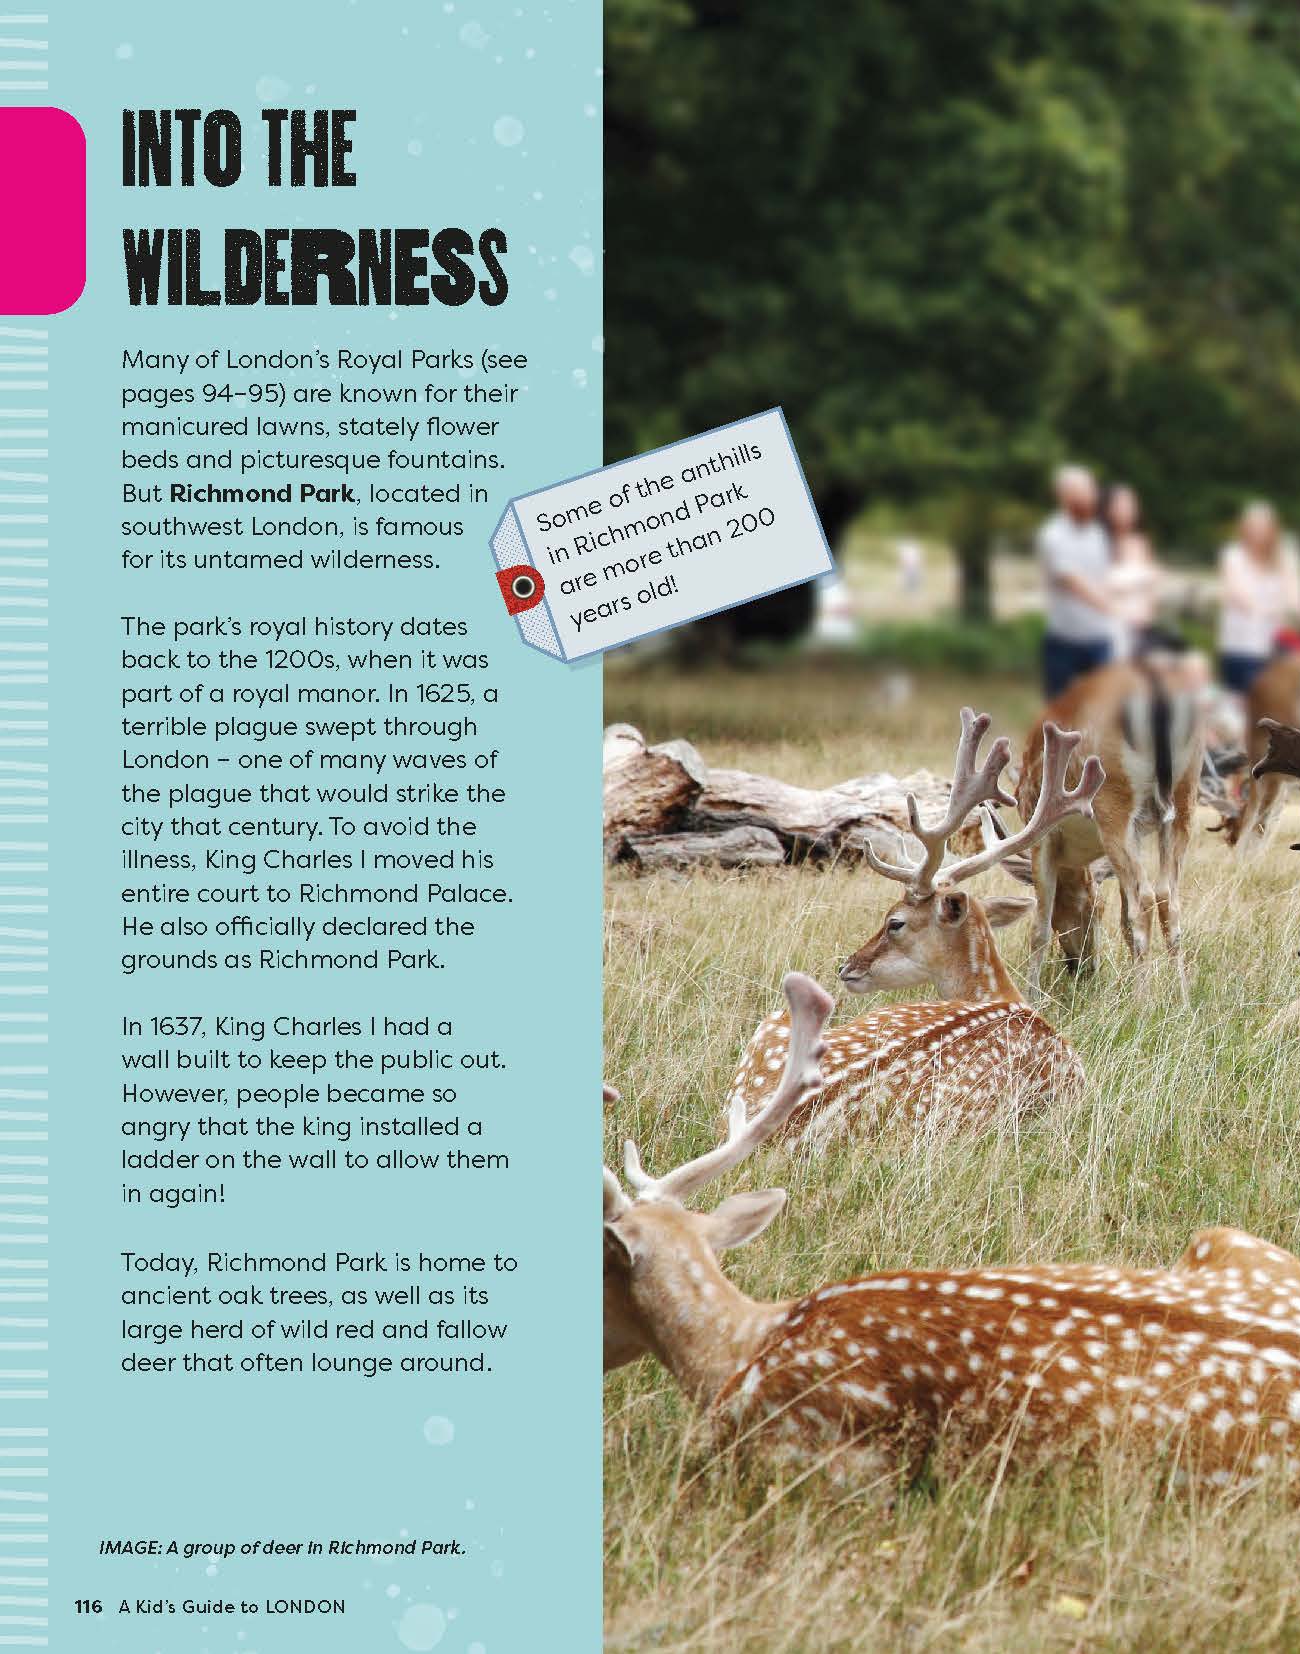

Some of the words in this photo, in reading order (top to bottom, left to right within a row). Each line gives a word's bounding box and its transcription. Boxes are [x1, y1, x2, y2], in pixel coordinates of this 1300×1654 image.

[123, 109, 241, 187] INTO
[262, 109, 356, 187] THE
[123, 228, 508, 306] WILDERNESS
[123, 350, 189, 374] Many
[196, 350, 220, 368] of
[228, 350, 329, 368] London’s
[339, 350, 401, 374] Royal
[413, 349, 473, 368] Parks
[482, 349, 527, 373] (see
[123, 389, 194, 408] pages
[203, 383, 285, 407] 94–95)
[294, 389, 331, 402] are
[341, 383, 416, 402] known
[425, 384, 457, 402] for
[464, 384, 518, 402] their
[123, 417, 247, 435] manicured
[258, 417, 329, 438] lawns,
[339, 417, 419, 441] stately
[427, 417, 499, 435] flower
[123, 450, 178, 468] beds
[187, 450, 231, 468] and
[242, 450, 380, 474] picturesque
[388, 450, 504, 468] fountains.
[124, 484, 162, 502] But
[171, 484, 291, 502] Richmond
[301, 484, 360, 505] Park,
[371, 484, 459, 502] located
[470, 484, 487, 502] in
[537, 501, 602, 532] Some
[610, 484, 631, 508] of
[636, 475, 674, 498] the
[682, 444, 762, 482] anthills
[122, 517, 243, 535] southwest
[253, 517, 343, 538] London,
[354, 517, 368, 535] is
[376, 517, 463, 535] famous
[547, 546, 570, 564] in
[574, 501, 691, 555] Richmond
[695, 483, 748, 513] Park
[560, 572, 597, 594] are
[603, 551, 662, 581] more
[666, 530, 722, 558] than
[727, 508, 774, 538] 200
[570, 597, 631, 632] years
[638, 575, 678, 603] old!
[121, 617, 165, 635] The
[175, 616, 241, 641] park’s
[251, 617, 305, 641] royal
[316, 617, 393, 641] history
[401, 617, 467, 635] dates
[122, 717, 206, 735] terrible
[216, 717, 297, 741] plague
[306, 718, 376, 741] swept
[384, 717, 476, 741] through
[122, 784, 160, 802] the
[170, 784, 251, 808] plague
[260, 784, 310, 802] that
[317, 784, 387, 802] would
[397, 783, 458, 802] strike
[467, 784, 505, 802] the
[122, 884, 189, 902] entire
[198, 885, 259, 902] court
[267, 885, 290, 902] to
[301, 884, 417, 902] Richmond
[429, 884, 512, 902] Palace.
[124, 917, 153, 935] He
[161, 917, 207, 935] also
[216, 916, 315, 941] officially
[323, 917, 426, 935] declared
[435, 917, 474, 935] the
[122, 950, 217, 974] grounds
[225, 955, 251, 968] as
[261, 950, 377, 968] Richmond
[389, 949, 444, 968] Park.
[124, 1017, 141, 1035] In
[151, 1017, 205, 1038] 1637,
[217, 1017, 264, 1041] King
[274, 1017, 361, 1035] Charles
[372, 1017, 374, 1035] I
[385, 1017, 428, 1035] had
[438, 1022, 451, 1035] a
[124, 1084, 227, 1105] However,
[238, 1084, 319, 1108] people
[328, 1084, 424, 1102] became
[433, 1089, 456, 1102] so
[122, 1122, 190, 1141] angry
[198, 1117, 248, 1135] that
[256, 1117, 294, 1135] the
[304, 1116, 350, 1141] king
[361, 1117, 458, 1135] installed
[468, 1122, 481, 1135] a
[121, 1253, 197, 1277] Today,
[209, 1253, 325, 1271] Richmond
[337, 1252, 387, 1271] Park
[396, 1253, 410, 1271] is
[420, 1253, 485, 1271] home
[494, 1254, 517, 1271] to
[123, 1320, 182, 1344] large
[192, 1320, 242, 1338] herd
[252, 1320, 276, 1338] of
[281, 1320, 327, 1338] wild
[337, 1320, 373, 1338] red
[383, 1320, 427, 1338] and
[437, 1320, 507, 1338] fallow
[122, 1353, 176, 1371] deer
[183, 1353, 233, 1371] that
[241, 1353, 302, 1371] often
[313, 1353, 392, 1377] lounge
[401, 1353, 491, 1371] around.
[100, 1541, 162, 1555] IMAGE:
[167, 1541, 178, 1555] A
[183, 1543, 235, 1558] group
[241, 1540, 259, 1555] of
[262, 1540, 302, 1555] deer
[422, 1541, 466, 1555] Park.
[75, 1600, 102, 1613] 116
[119, 1600, 130, 1613] A
[137, 1600, 175, 1613] Kid’s
[183, 1600, 235, 1613] Guide
[241, 1601, 258, 1613] to
[267, 1600, 344, 1613] LONDON
